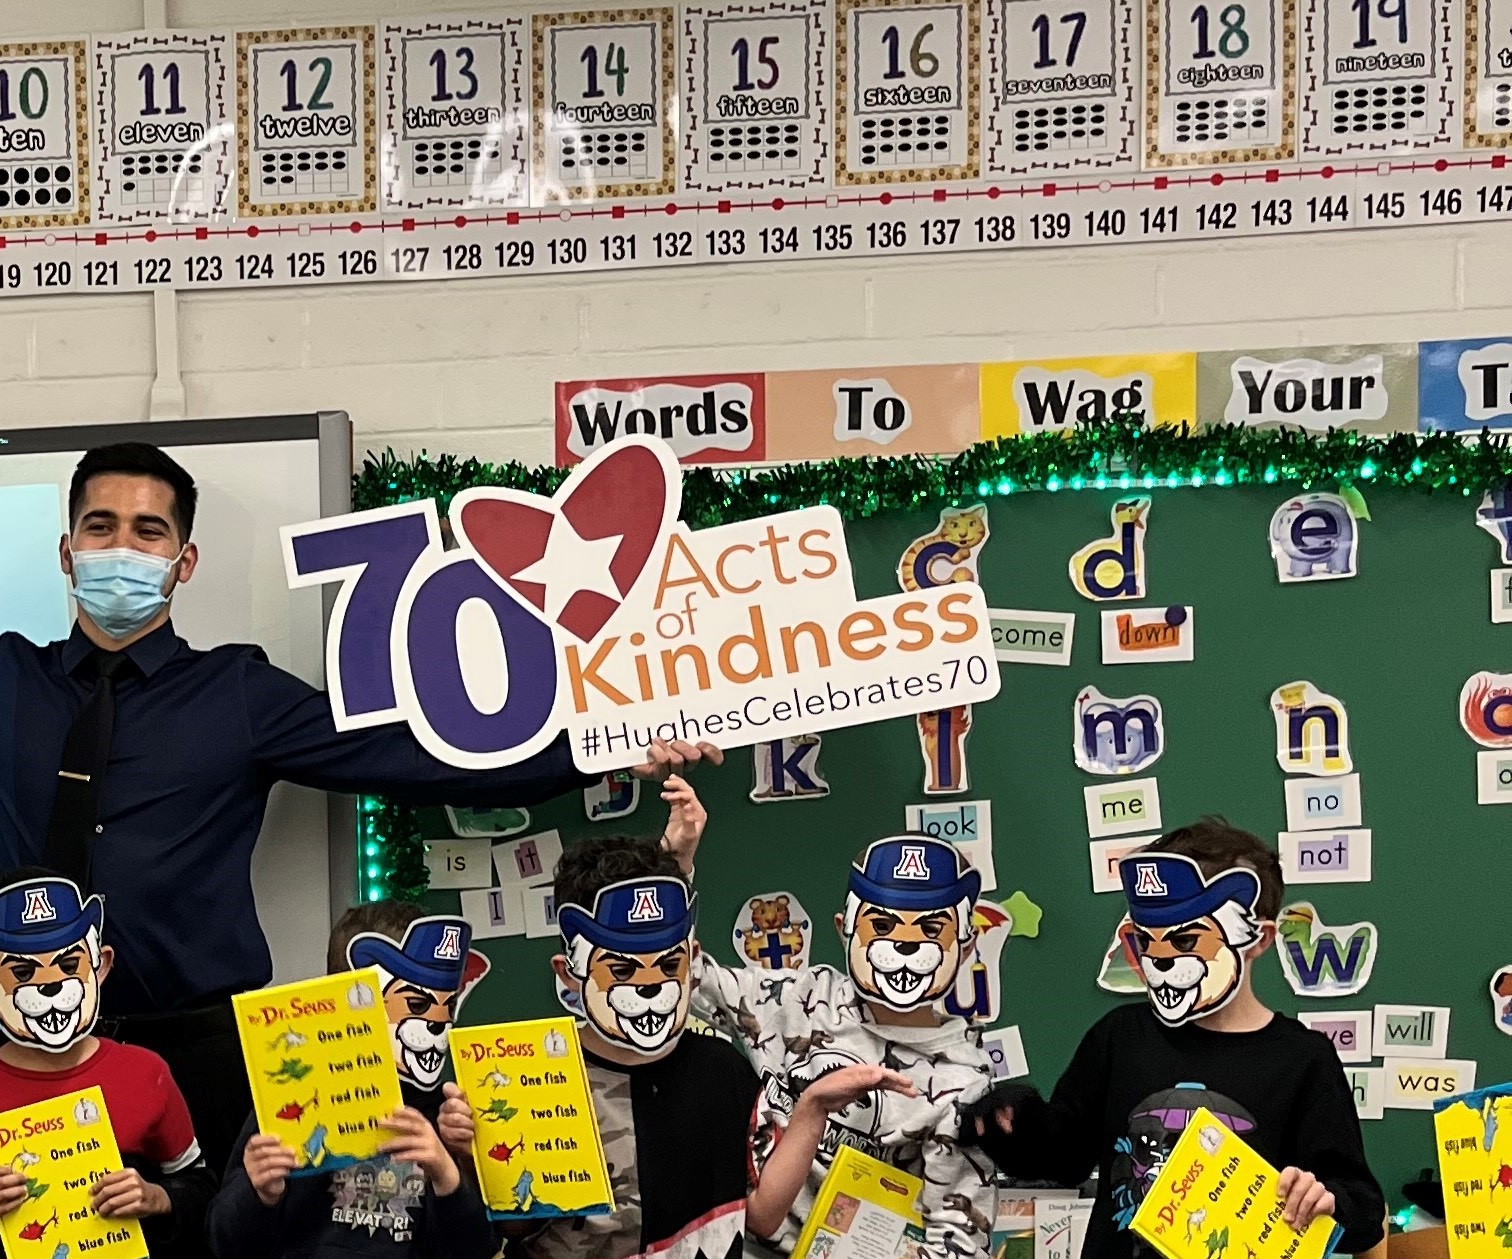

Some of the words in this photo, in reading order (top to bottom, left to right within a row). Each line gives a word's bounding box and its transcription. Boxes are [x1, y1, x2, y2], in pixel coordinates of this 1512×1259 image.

[1032, 12, 1087, 69] 17
[1190, 3, 1250, 60] 18
[1354, 0, 1407, 49] 19
[730, 36, 780, 92] 15
[881, 23, 939, 79] 16
[1337, 50, 1425, 74] nineteen
[279, 56, 334, 113] 12
[429, 45, 480, 100] 13
[580, 42, 630, 97] 14
[1006, 72, 1112, 97] seventeen
[1177, 60, 1264, 87] eighteen
[137, 62, 185, 117] 11
[718, 93, 798, 117] fifteen
[864, 82, 951, 107] sixteen
[260, 112, 351, 139] twelve
[404, 105, 500, 129] thirteen
[554, 100, 655, 125] fourteen
[119, 120, 205, 146] eleven
[83, 260, 118, 286] 121
[235, 253, 274, 280] 124
[391, 246, 430, 273] 127
[546, 237, 587, 265] 130
[705, 229, 746, 256] 133
[866, 221, 907, 249] 136
[1029, 212, 1071, 240] 139
[1195, 202, 1237, 231] 142
[1363, 192, 1405, 220] 145
[573, 393, 750, 445] Words
[839, 389, 906, 431] To
[1023, 378, 1145, 430] Wag
[1239, 369, 1375, 411] Your
[1290, 507, 1338, 554] e
[654, 527, 837, 610] Acts
[1083, 522, 1136, 598] d
[292, 512, 557, 754] 70
[656, 592, 698, 640] of
[1120, 617, 1178, 648] down
[565, 592, 980, 713] Kindness
[990, 624, 1063, 647] come
[581, 655, 989, 757] #HughesCelebrates70
[1083, 706, 1158, 755] m
[1288, 706, 1339, 760] n
[1102, 795, 1143, 818] me
[1307, 793, 1338, 811] no
[920, 811, 975, 837] look
[447, 850, 465, 873] is
[517, 846, 536, 877] it
[893, 845, 931, 880] A
[1301, 840, 1347, 867] not
[628, 887, 665, 923] A
[1388, 1012, 1433, 1042] will
[1399, 1073, 1455, 1093] was
